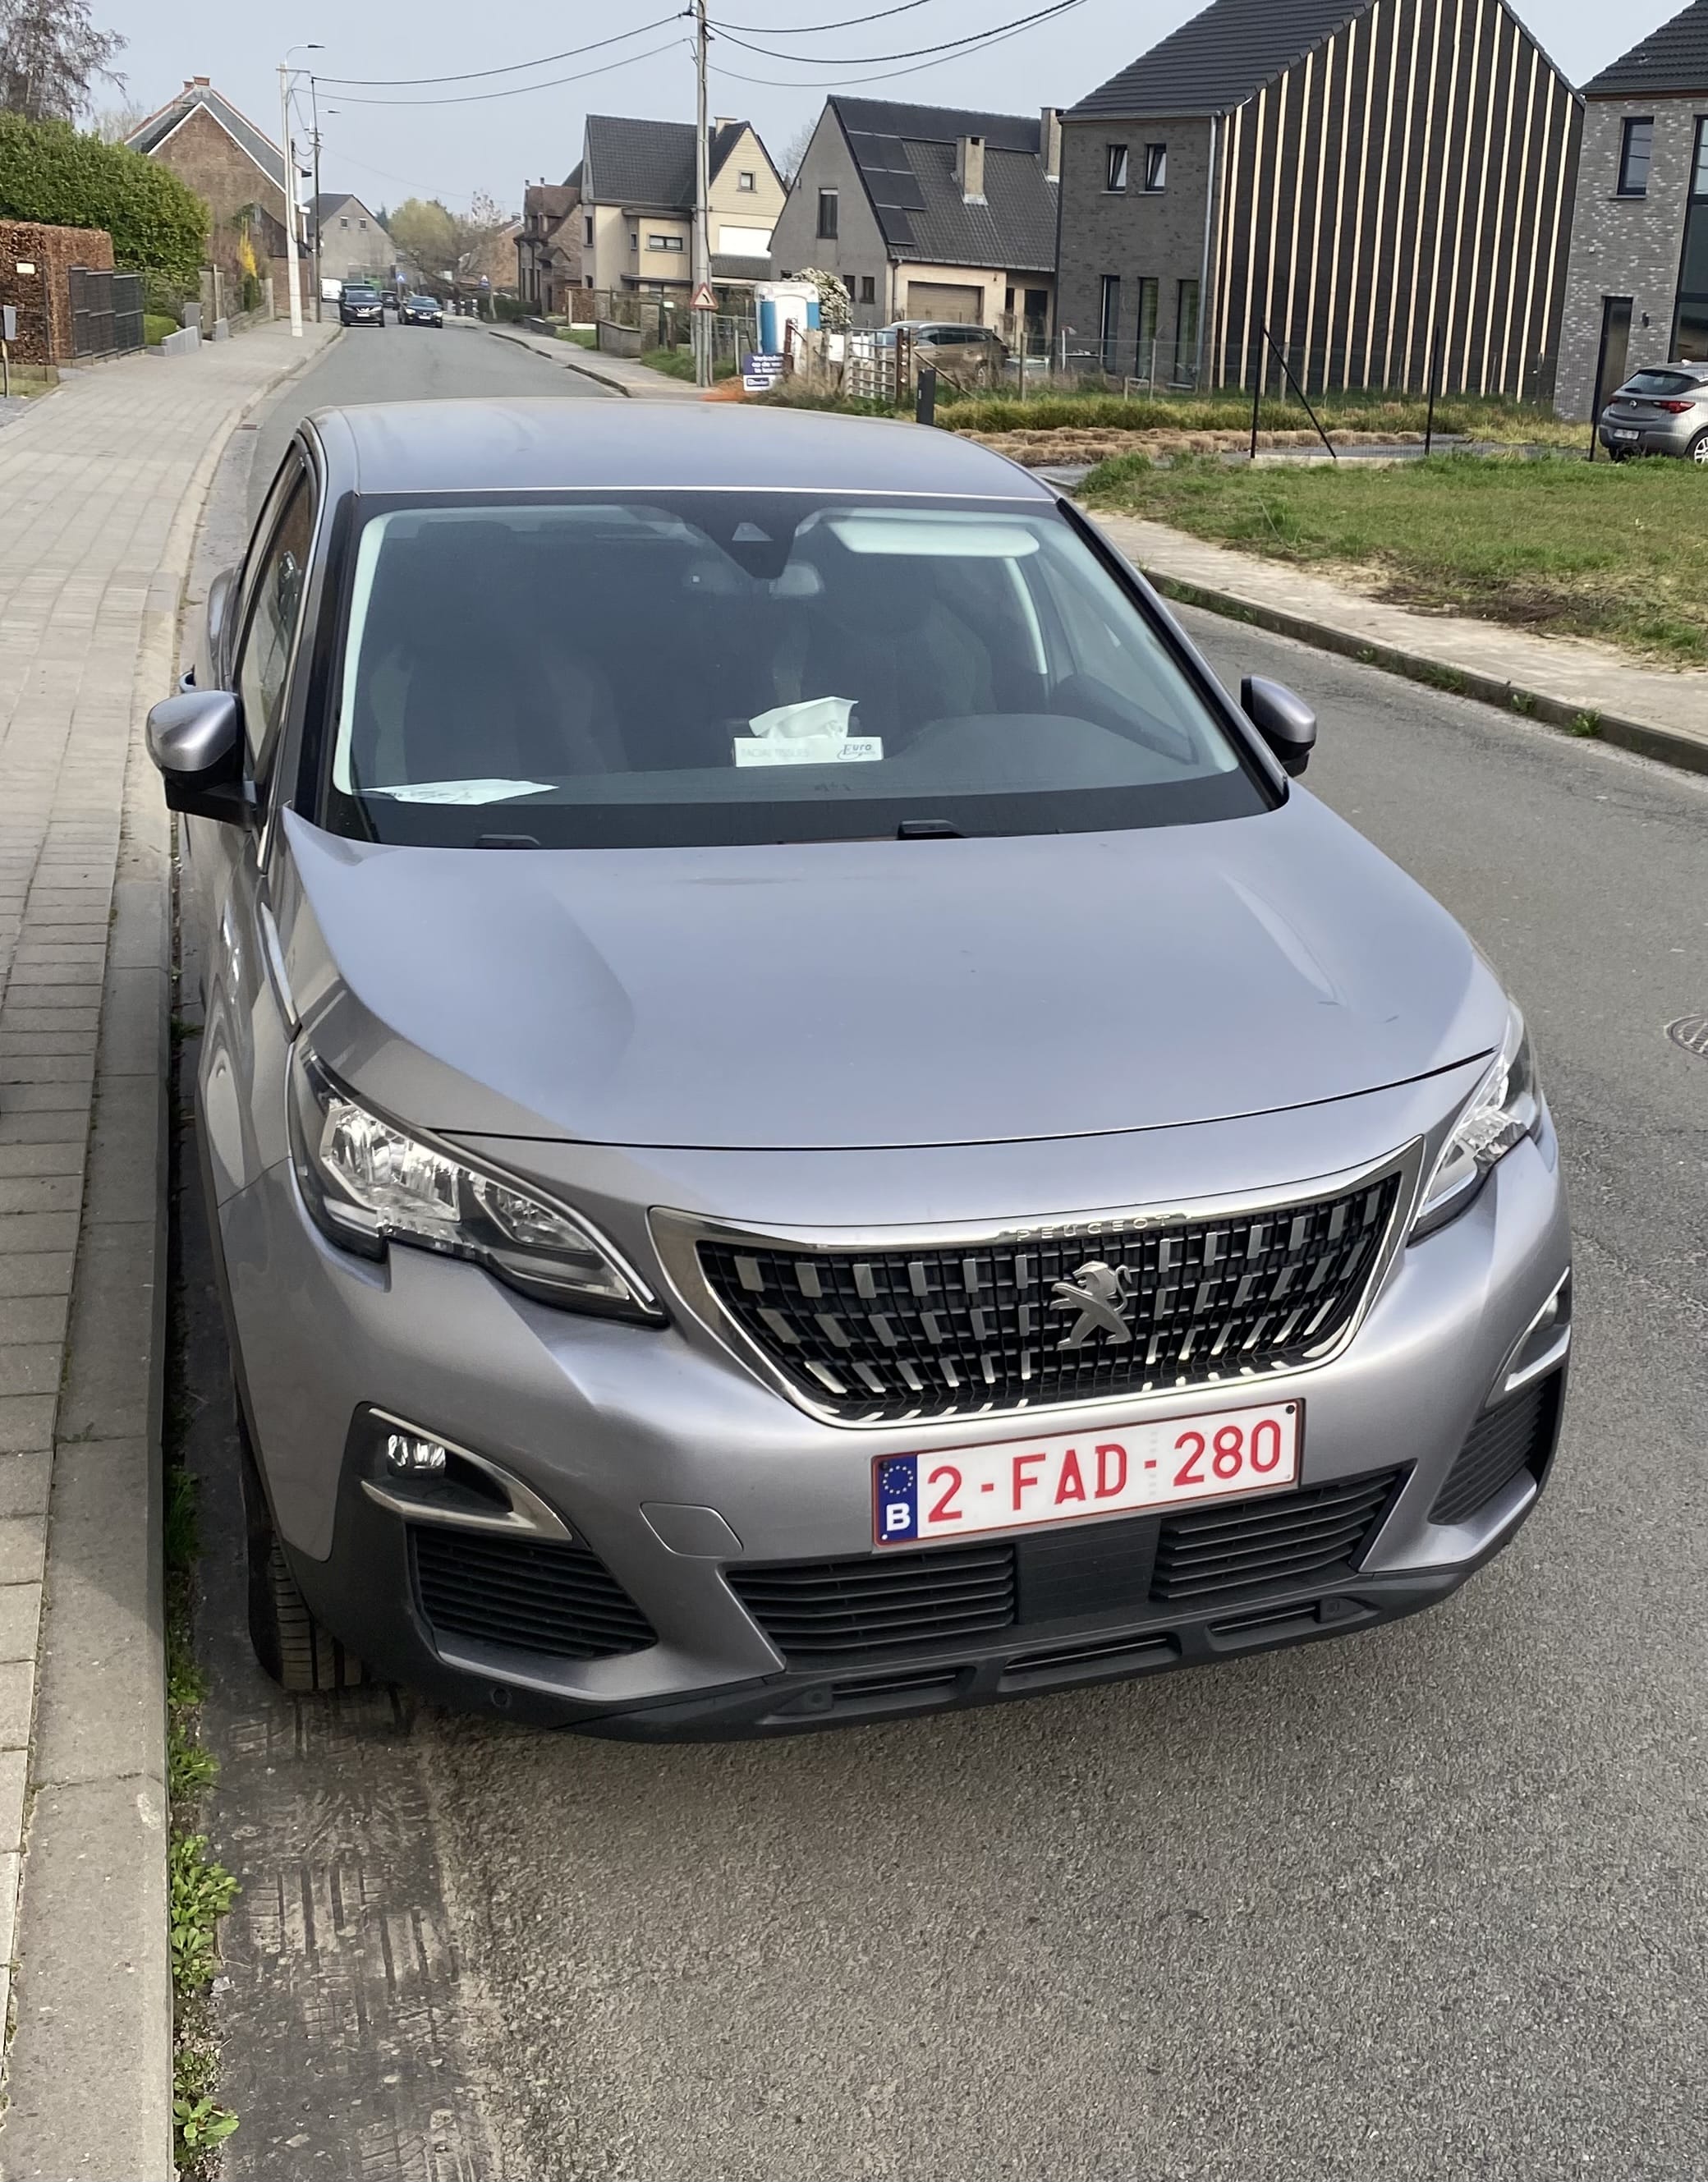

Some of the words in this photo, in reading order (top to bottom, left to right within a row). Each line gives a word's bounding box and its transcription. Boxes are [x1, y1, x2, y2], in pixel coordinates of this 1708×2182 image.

[843, 743, 872, 756] Euro
[1016, 1214, 1171, 1242] PEUGEOT
[927, 1419, 1281, 1523] 2-FAD-280
[886, 1503, 911, 1532] B
